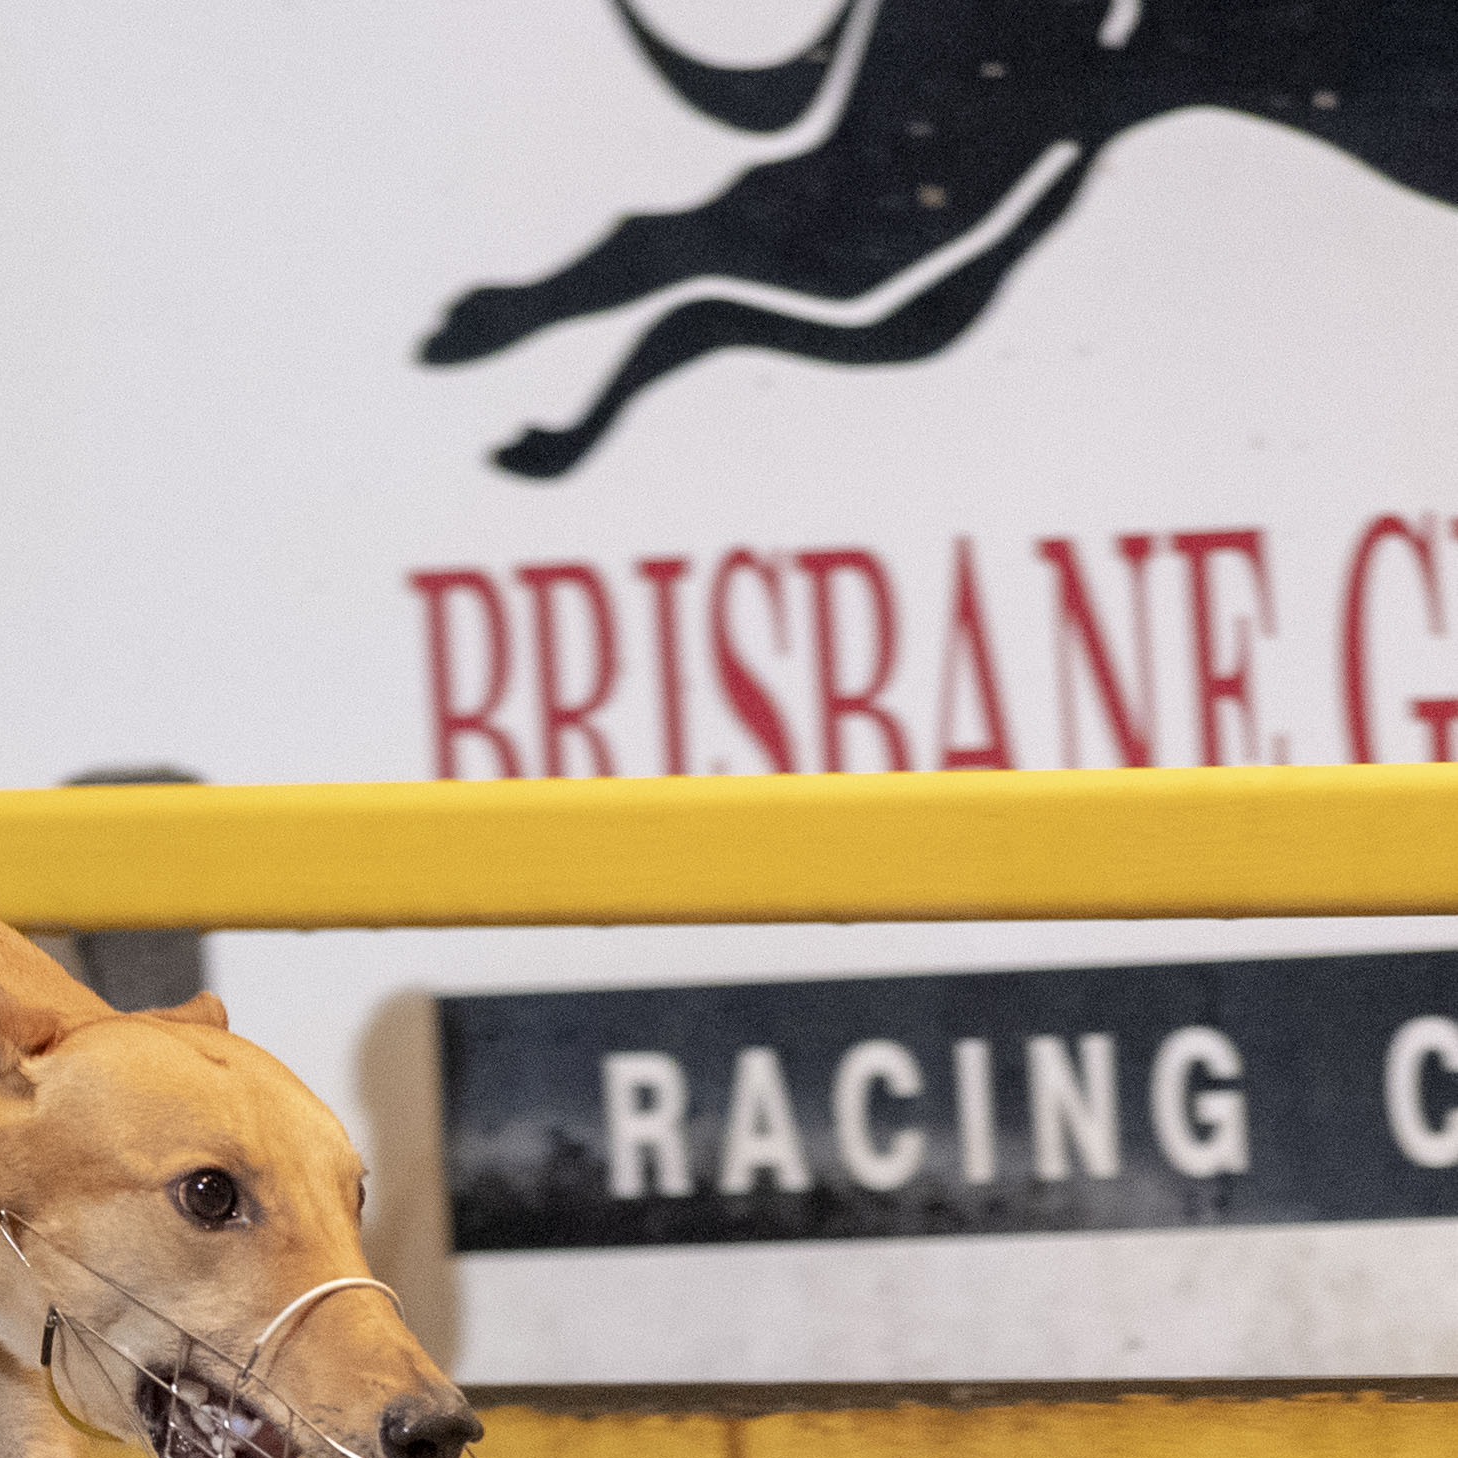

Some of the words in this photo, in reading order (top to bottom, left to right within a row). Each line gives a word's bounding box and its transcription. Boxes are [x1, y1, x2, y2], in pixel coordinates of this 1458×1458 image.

[405, 526, 1289, 780] BRISBANE
[1333, 508, 1458, 766] G
[603, 1026, 1250, 1200] RACING
[1384, 1015, 1458, 1168] C
